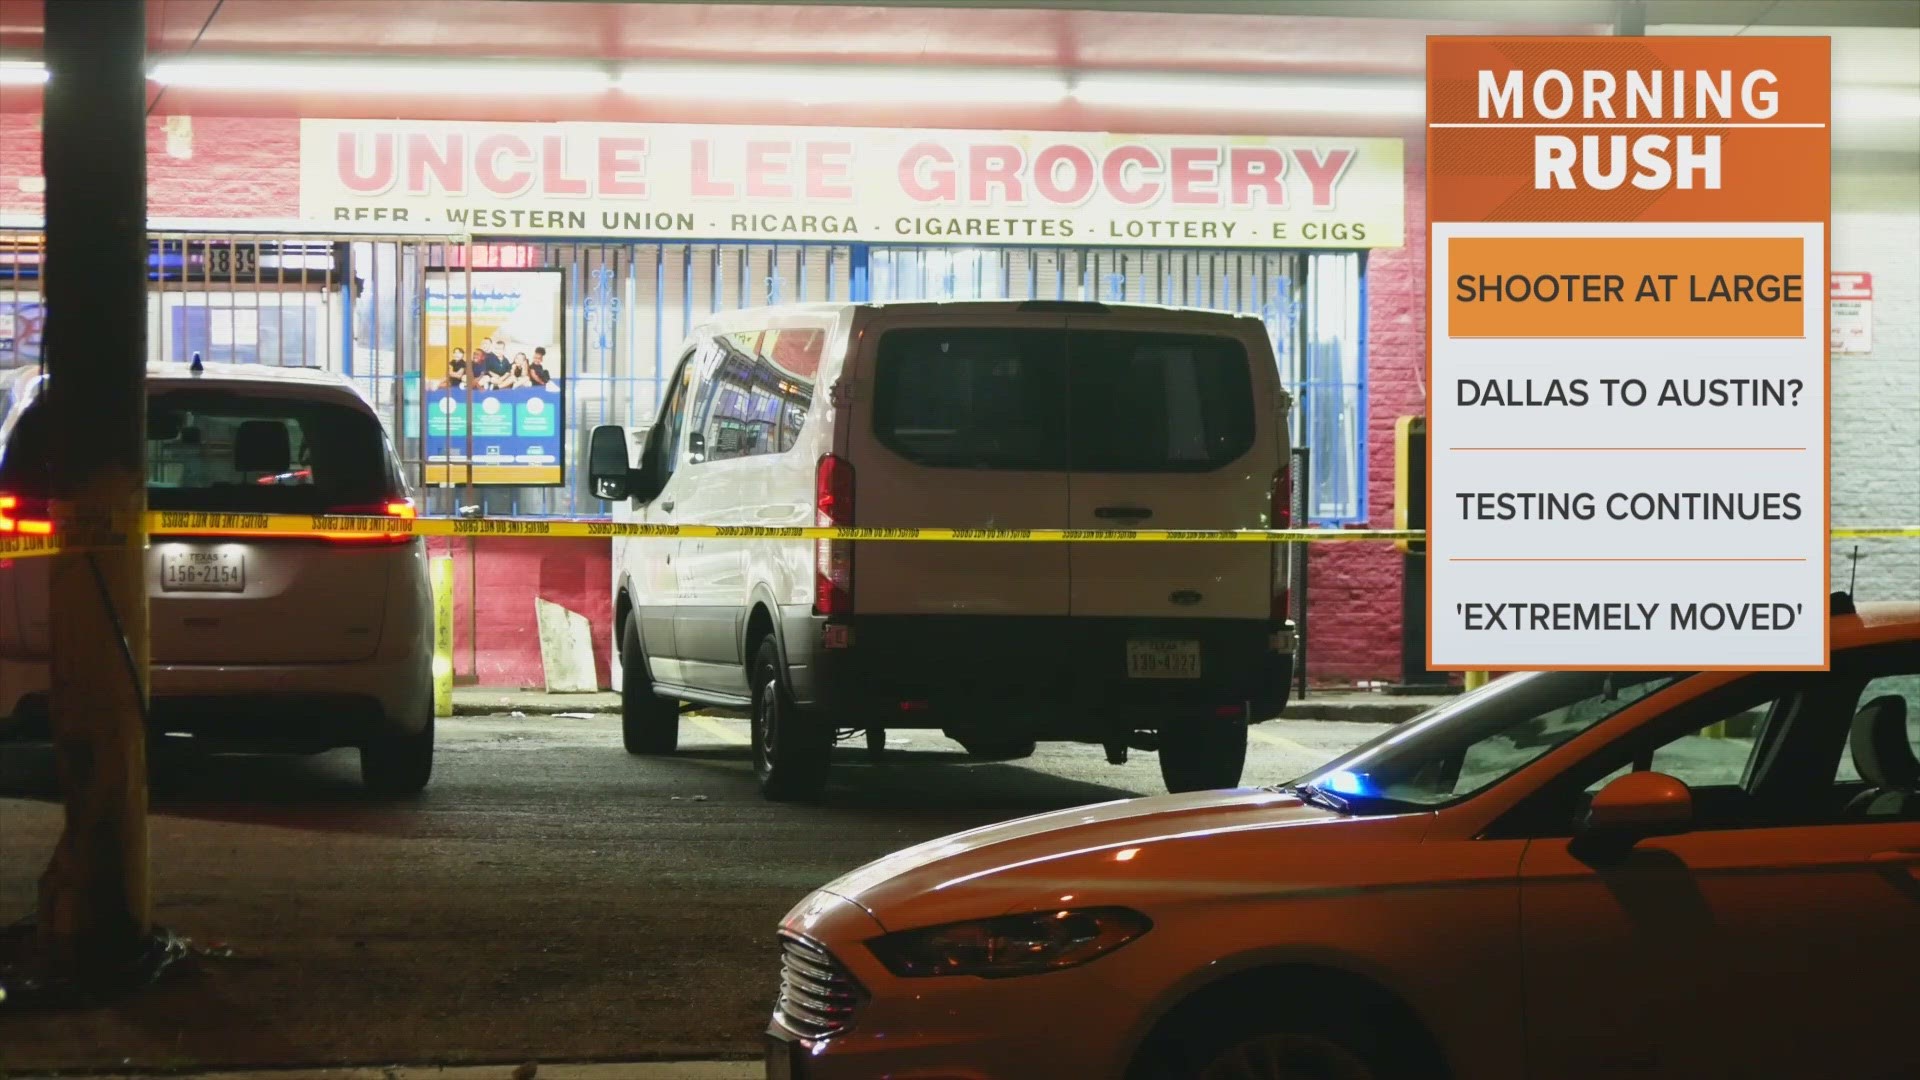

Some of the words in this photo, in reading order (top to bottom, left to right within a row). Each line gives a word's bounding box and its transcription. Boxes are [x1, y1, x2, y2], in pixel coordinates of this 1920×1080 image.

[337, 132, 646, 195] UNCLE
[690, 139, 853, 199] LEE
[898, 142, 1351, 206] GROCERY
[446, 209, 586, 229] WESTERN
[602, 212, 694, 231] UNION
[731, 214, 858, 234] RICARGA
[894, 217, 1074, 237] CIGARETTES
[1110, 220, 1236, 239] LOTTERY
[1273, 222, 1287, 239] E
[1302, 223, 1366, 241] CIGS
[161, 513, 190, 528] CROSS
[191, 513, 208, 528] NOT
[209, 513, 220, 528] DO
[222, 513, 239, 528] LINE
[241, 513, 268, 528] POLICE
[312, 517, 338, 532] CROSS
[340, 517, 355, 532] NOT
[357, 517, 368, 532] DO
[369, 517, 385, 532] LINE
[387, 517, 412, 532] POLICE
[453, 520, 479, 534] CROSS
[480, 520, 495, 534] NOT
[496, 520, 507, 534] DO
[508, 520, 523, 534] LINE
[525, 520, 550, 534] POLICE
[190, 553, 218, 561] TEXAS
